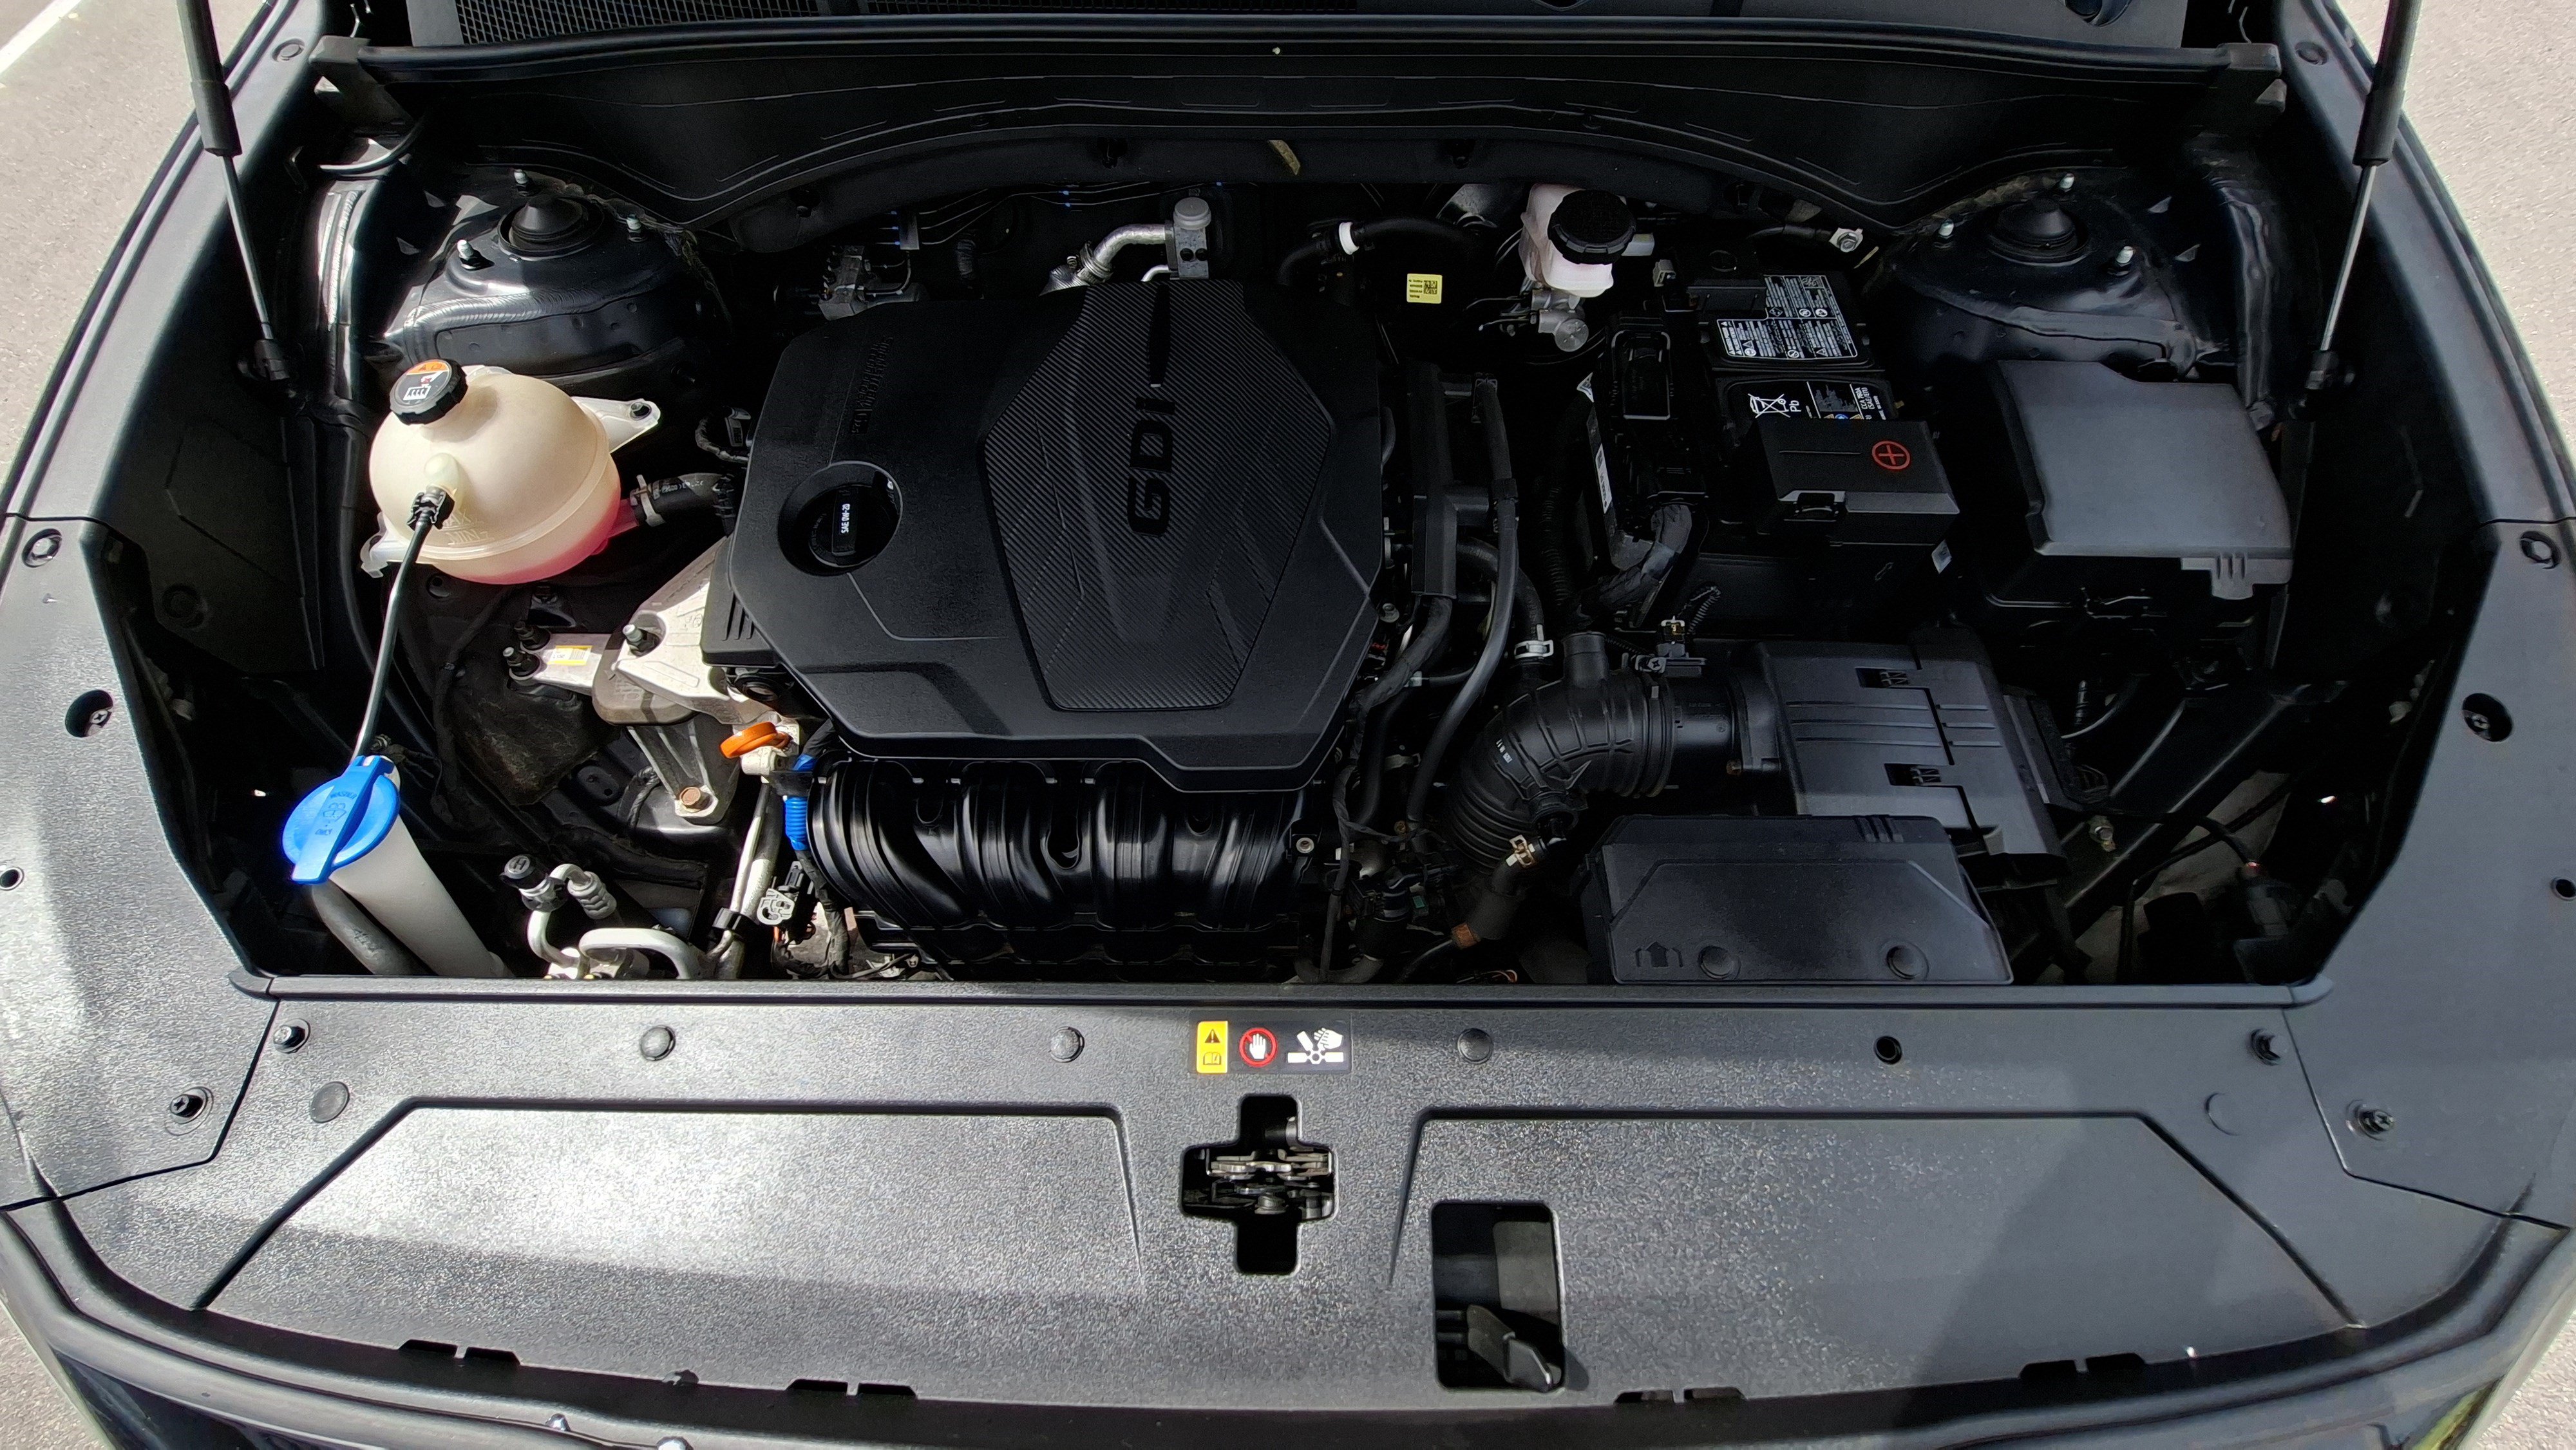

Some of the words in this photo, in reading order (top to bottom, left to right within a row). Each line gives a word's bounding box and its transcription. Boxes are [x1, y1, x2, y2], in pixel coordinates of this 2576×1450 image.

[1788, 400, 1802, 413] Pb
[841, 504, 851, 522] 0W-20
[840, 522, 849, 534] SAE
[513, 858, 527, 871] H
